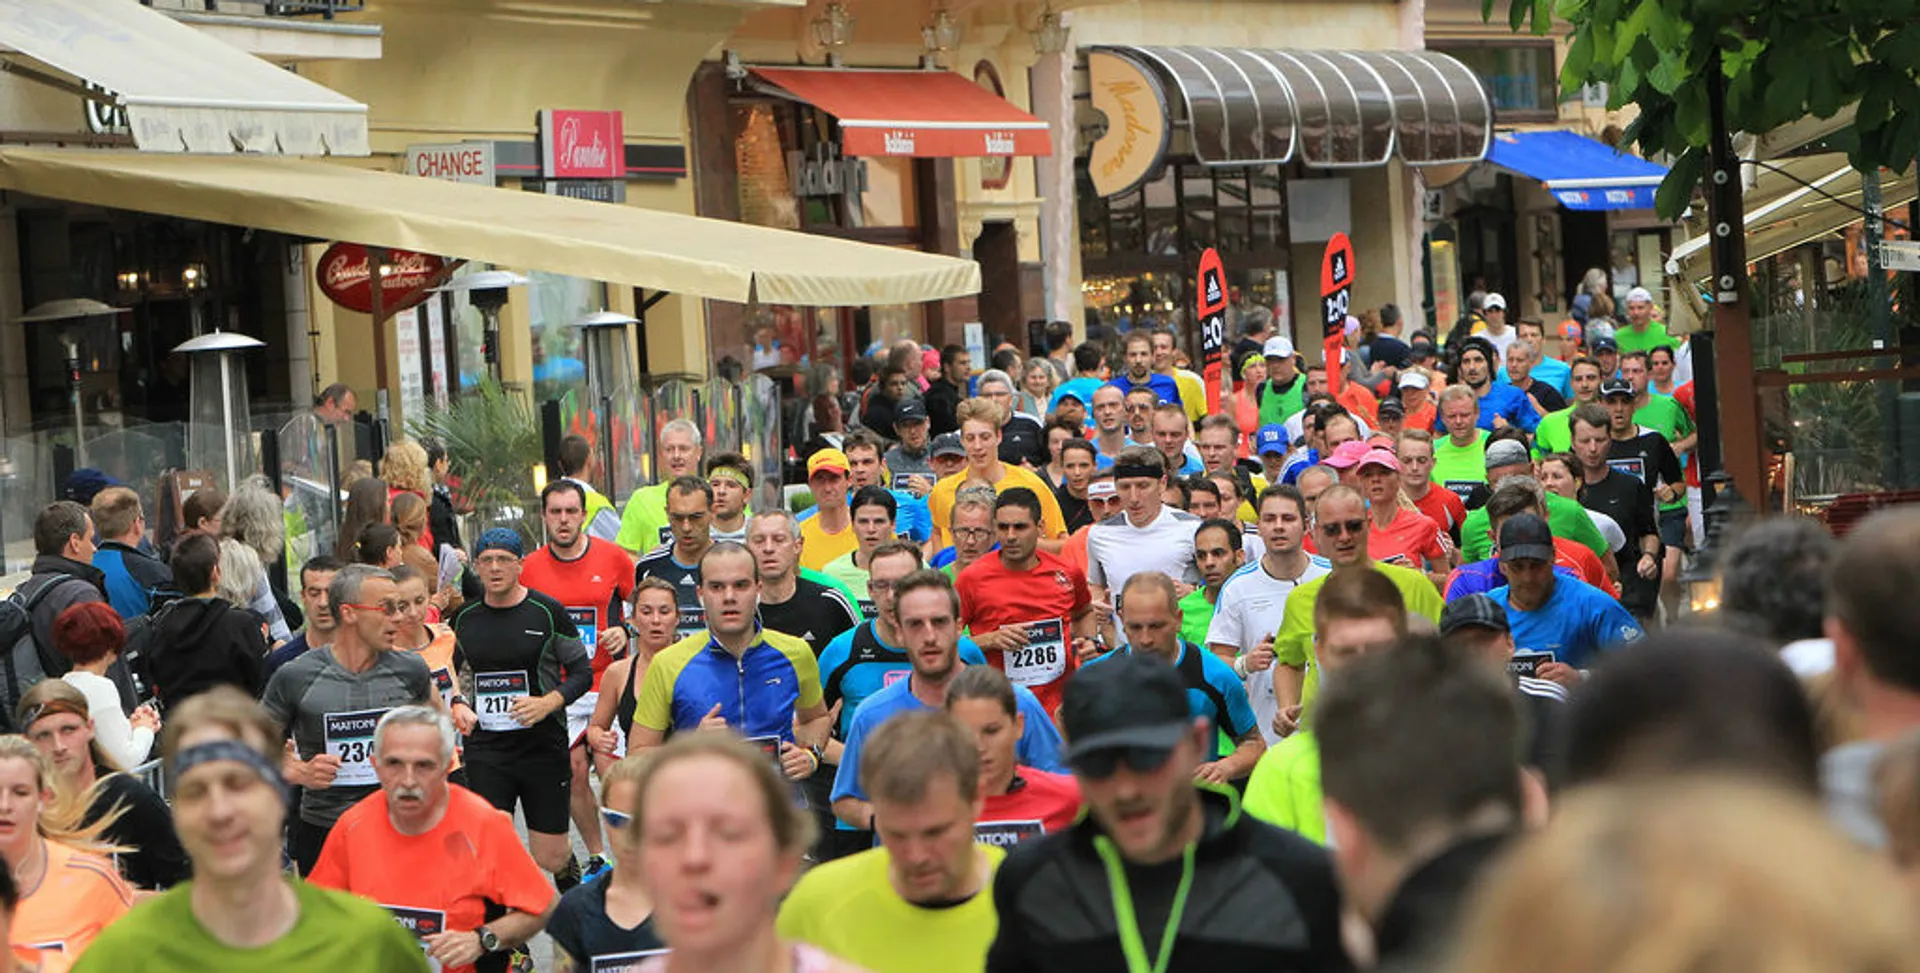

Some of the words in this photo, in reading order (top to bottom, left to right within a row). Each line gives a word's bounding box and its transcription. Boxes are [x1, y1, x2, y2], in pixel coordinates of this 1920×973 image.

[416, 151, 484, 177] CHANGE
[1012, 645, 1057, 669] 2286
[330, 718, 377, 732] MATTONI
